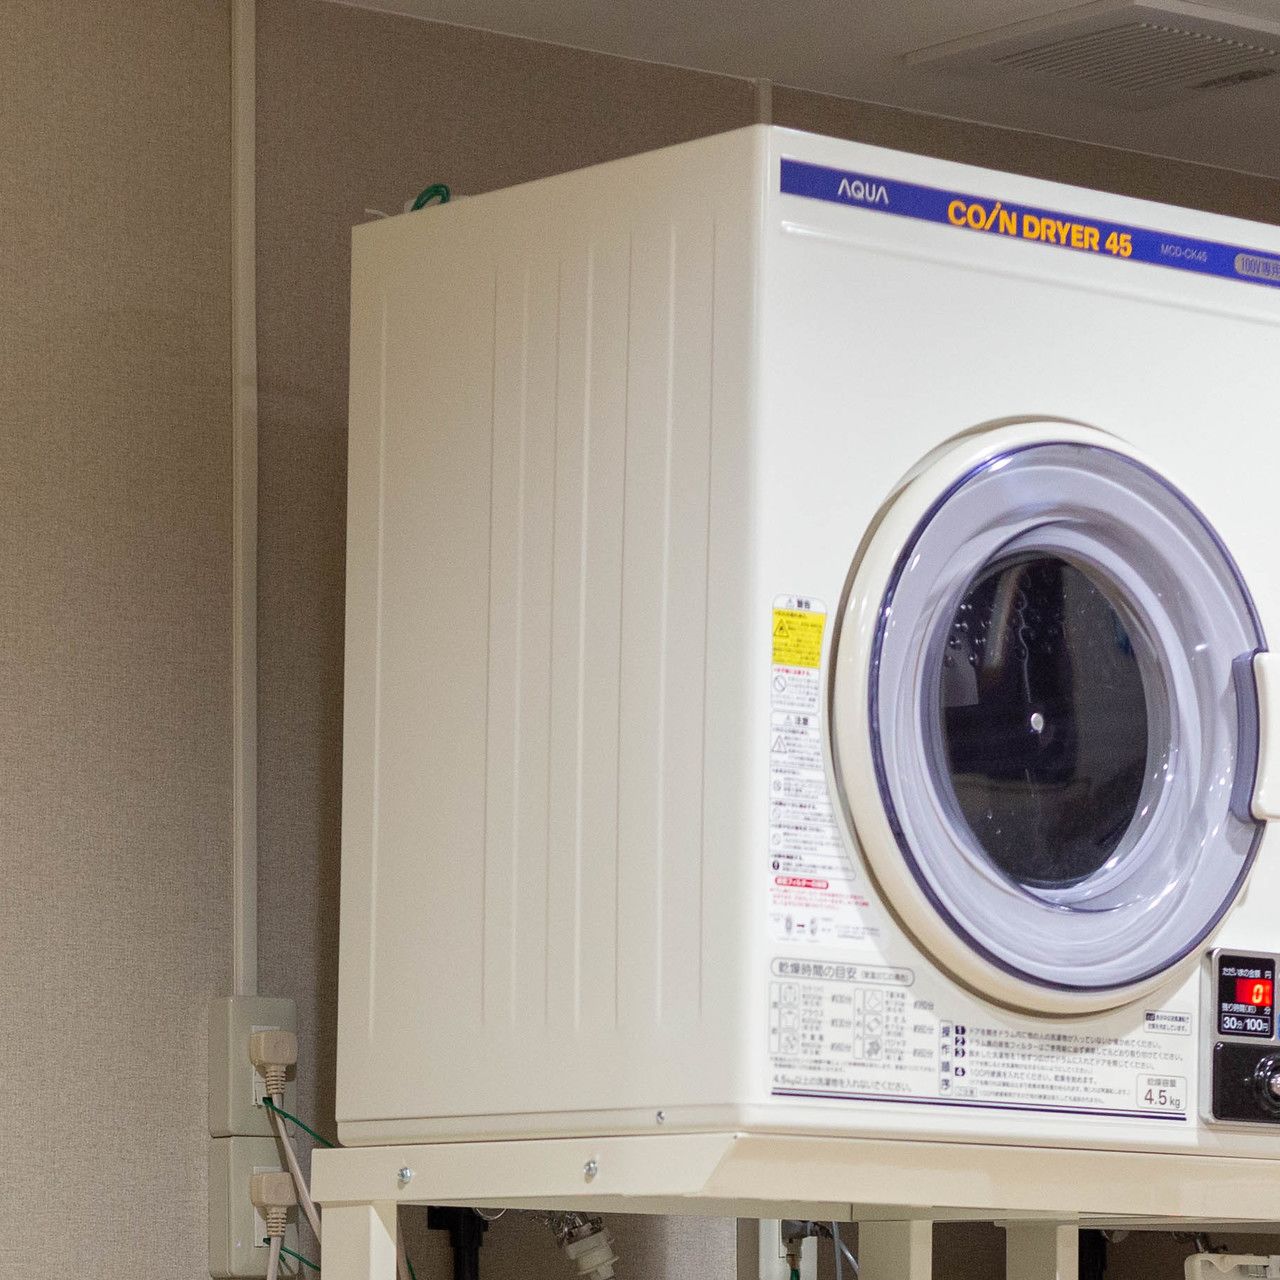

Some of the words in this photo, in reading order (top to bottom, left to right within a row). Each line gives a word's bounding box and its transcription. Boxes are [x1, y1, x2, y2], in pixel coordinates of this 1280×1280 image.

[837, 178, 889, 204] AQUA
[1022, 214, 1099, 252] DRYER
[1105, 231, 1132, 257] 45
[1144, 1089, 1167, 1105] 4.5
